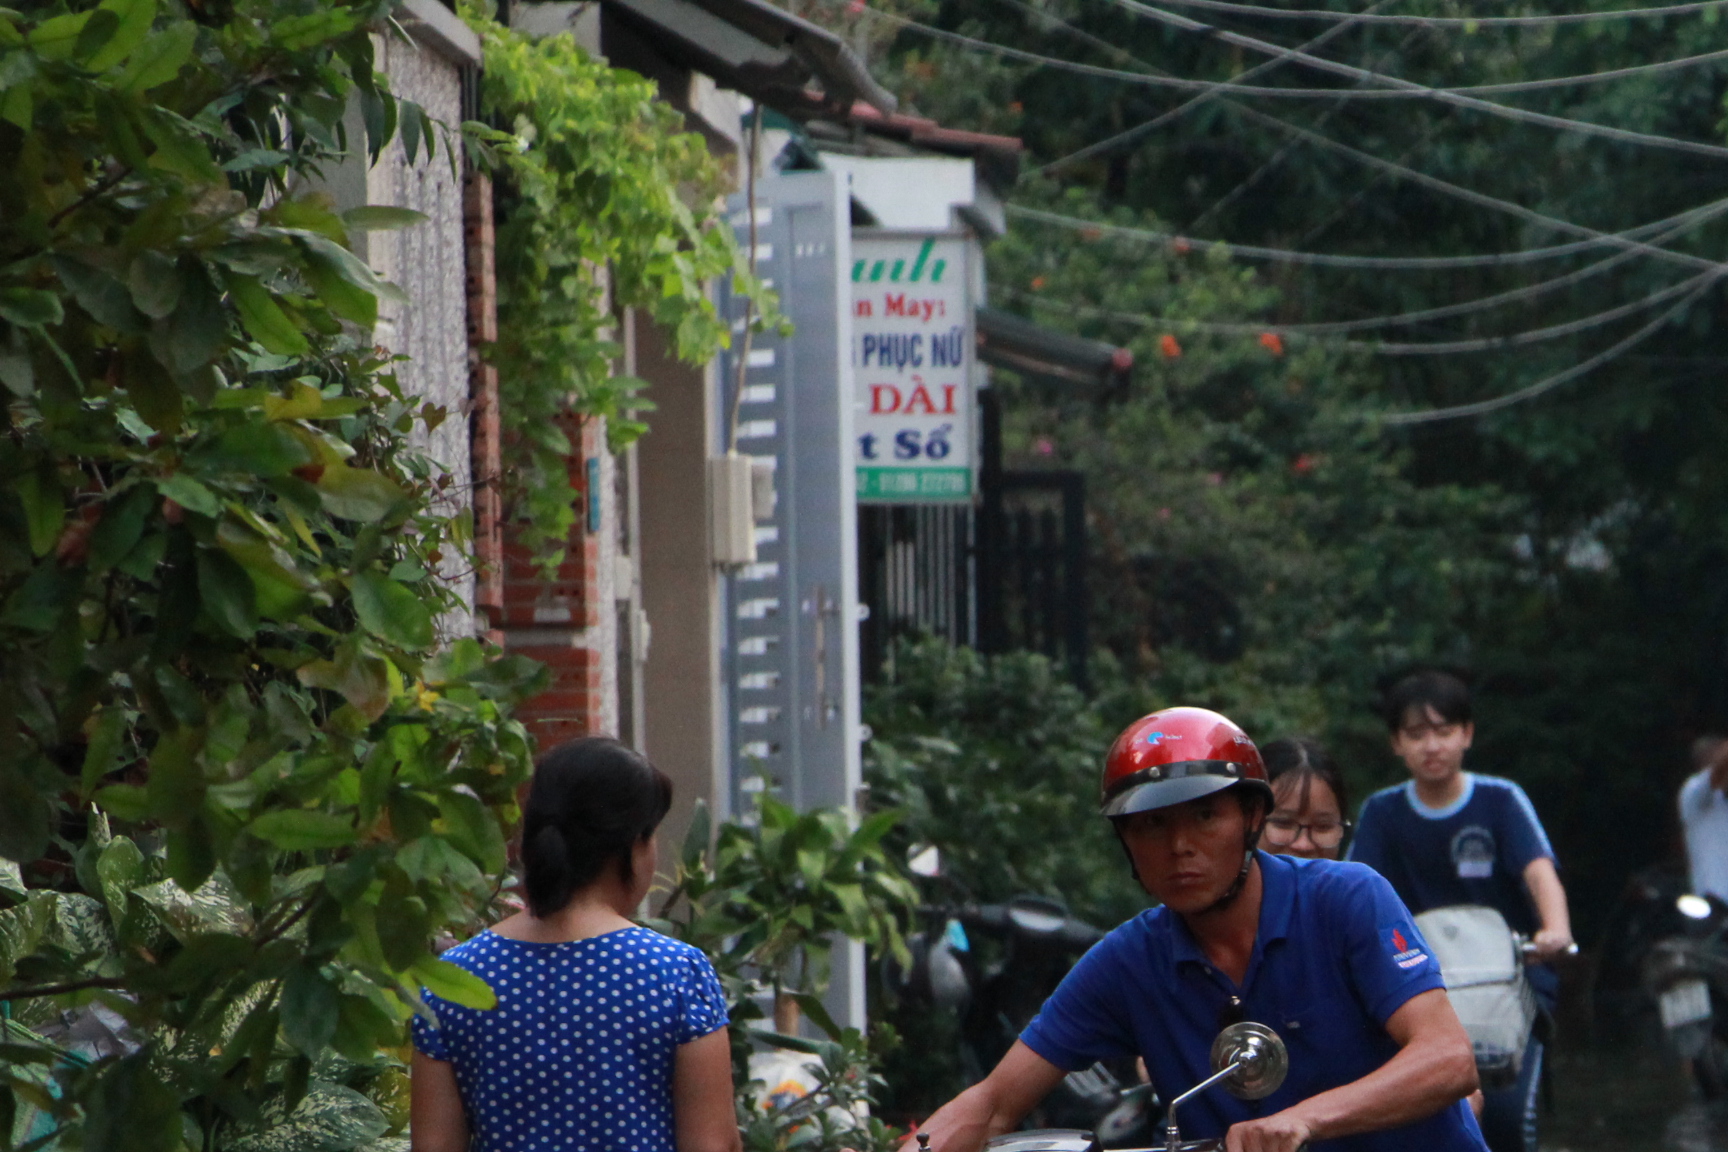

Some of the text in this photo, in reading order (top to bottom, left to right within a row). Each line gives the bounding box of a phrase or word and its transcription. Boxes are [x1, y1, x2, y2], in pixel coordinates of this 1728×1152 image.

[863, 333, 922, 373] PHỤC
[869, 375, 956, 415] DÀI
[894, 424, 953, 461] Số
